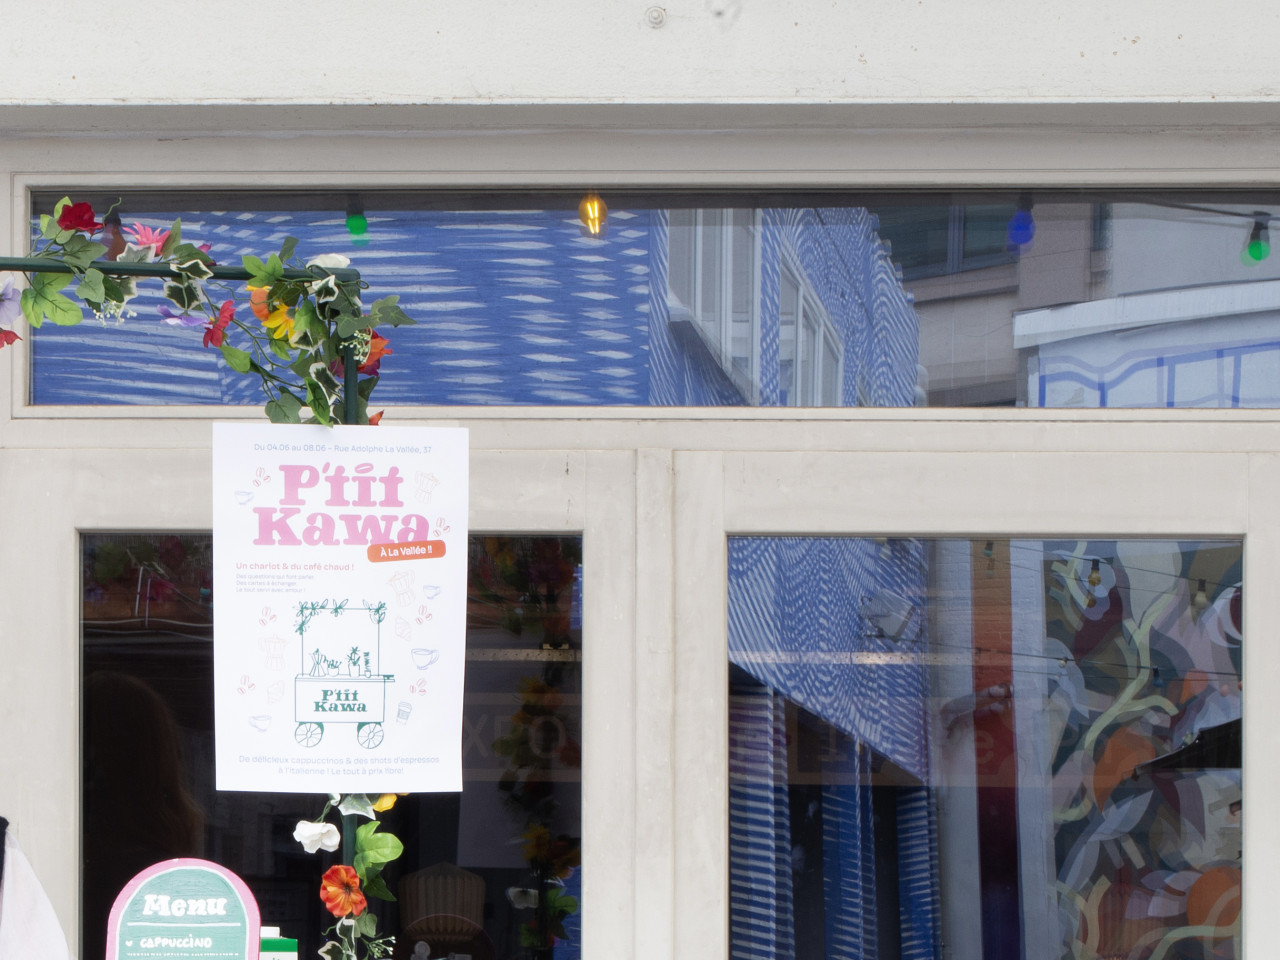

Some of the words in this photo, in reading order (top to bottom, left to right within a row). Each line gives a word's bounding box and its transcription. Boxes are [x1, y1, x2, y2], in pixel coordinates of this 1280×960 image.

[254, 443, 265, 451] Du
[292, 444, 302, 452] au
[334, 444, 350, 453] Rue
[351, 445, 384, 455] Adolphe
[278, 462, 404, 507] P'tit
[253, 507, 430, 546] Kawa
[380, 546, 387, 557] À
[388, 548, 399, 557] La
[400, 546, 426, 556] Vallée
[236, 562, 248, 570] Un
[249, 562, 280, 570] chariot
[282, 562, 289, 570] &
[290, 562, 302, 571] du
[303, 563, 322, 571] café
[323, 563, 350, 571] chaud
[321, 688, 359, 701] P'tit
[313, 701, 368, 712] Kawa
[252, 755, 289, 764] délicieux
[291, 757, 344, 765] cappuccinos
[354, 756, 368, 764] des
[370, 756, 392, 765] shots
[368, 768, 383, 777] prix
[142, 894, 227, 916] Menu
